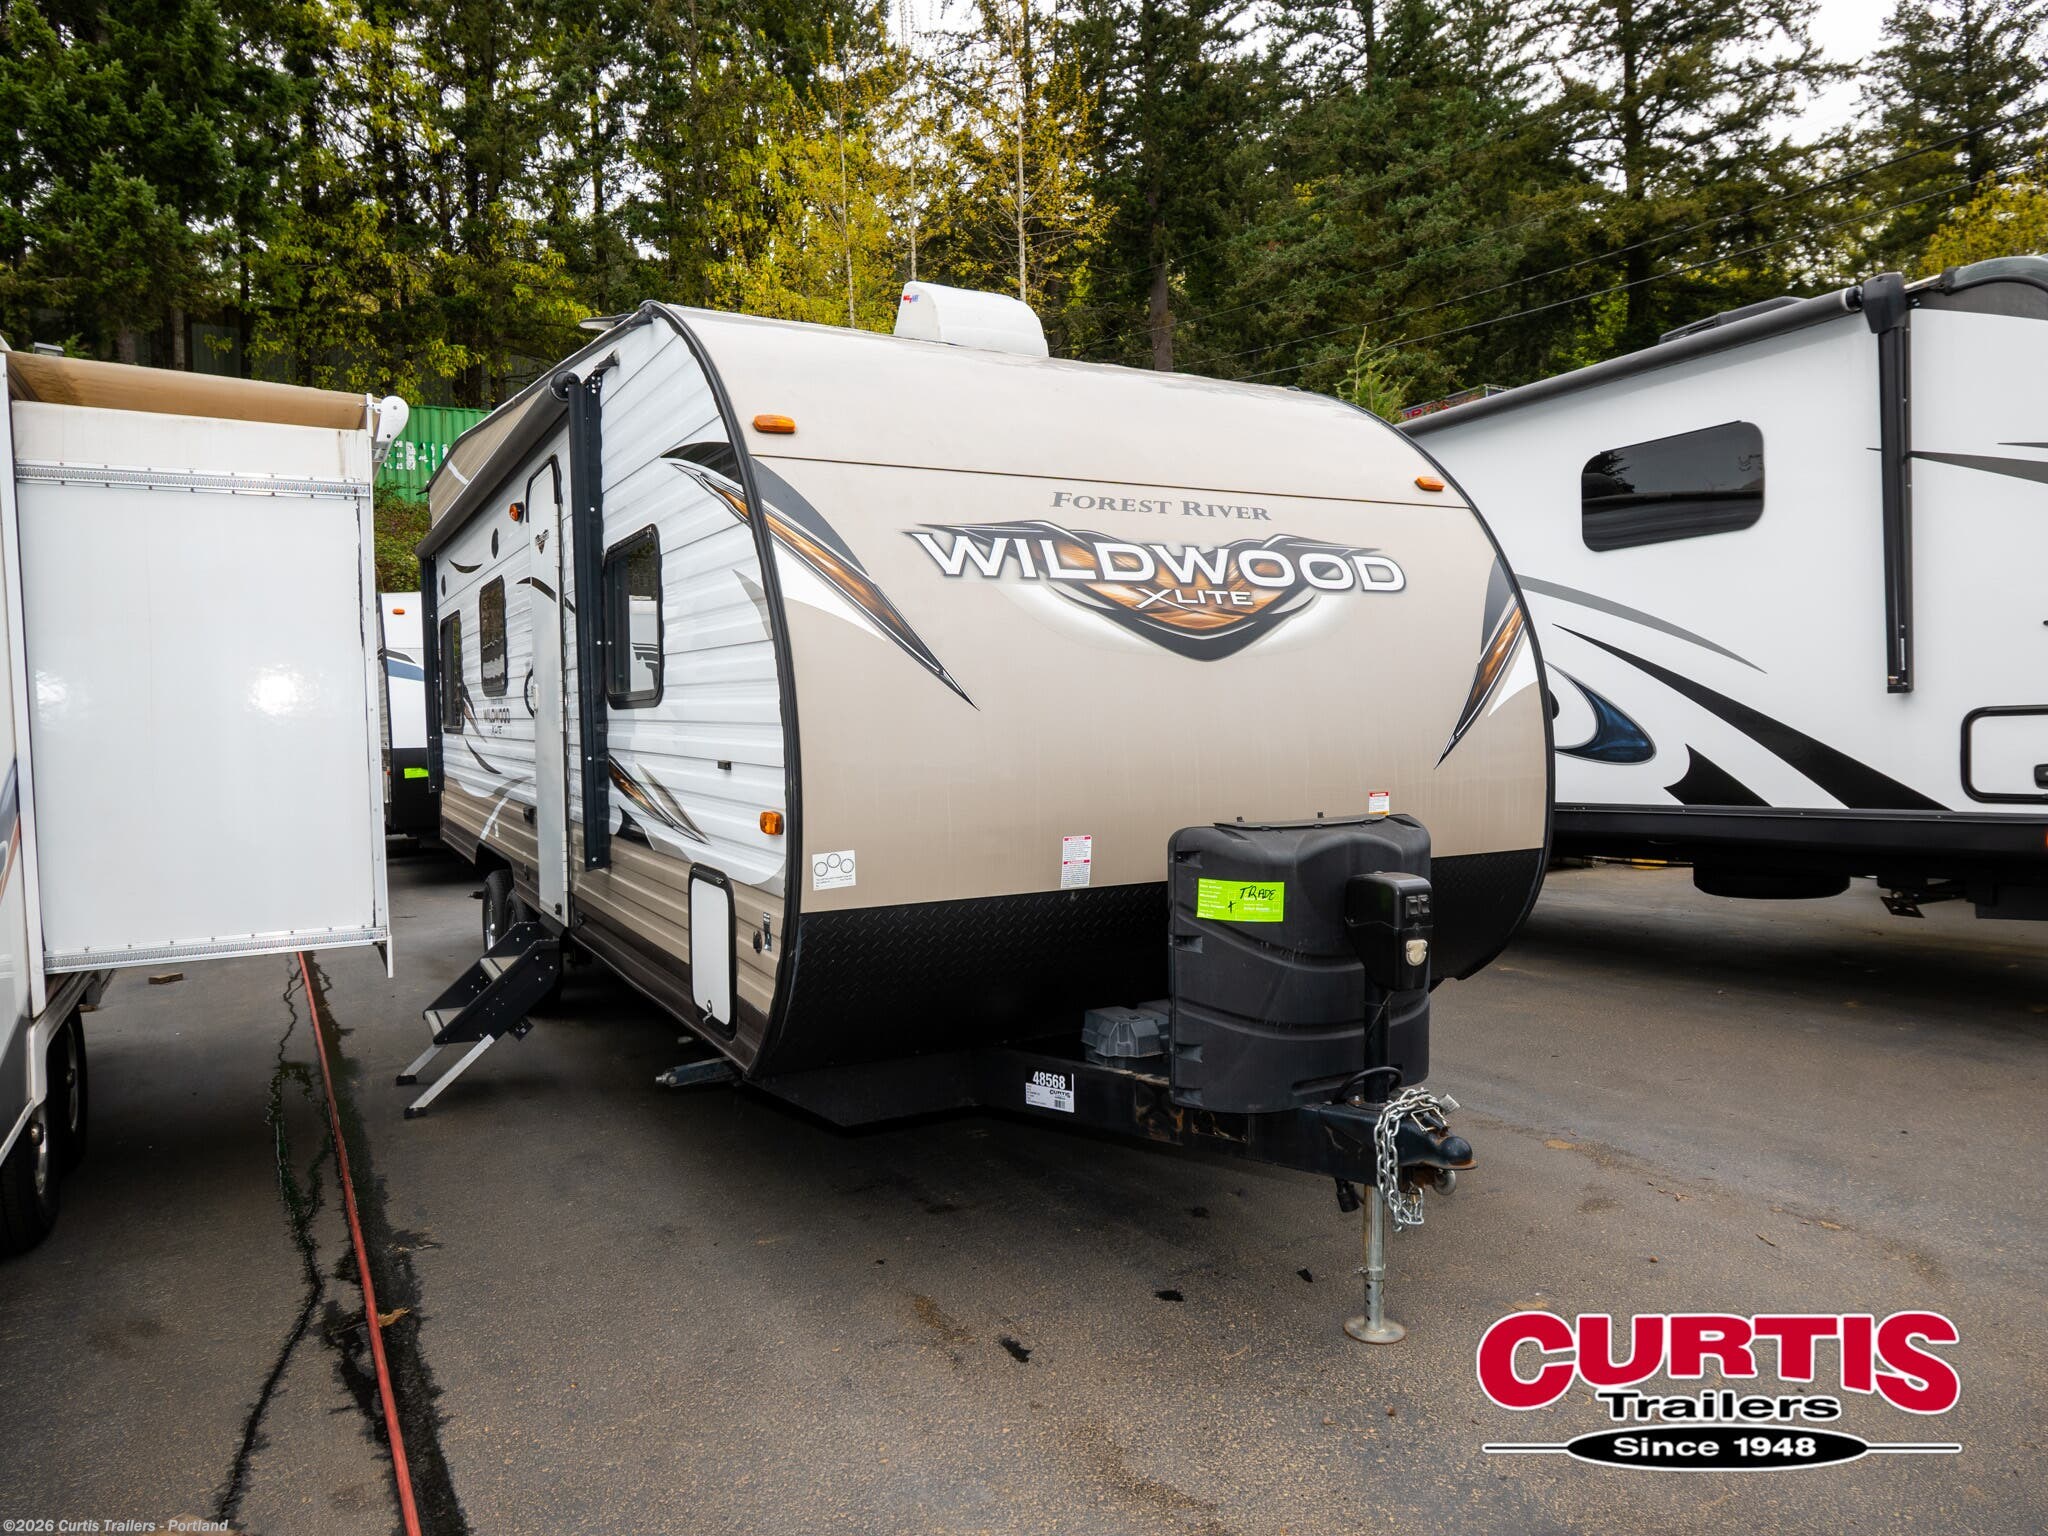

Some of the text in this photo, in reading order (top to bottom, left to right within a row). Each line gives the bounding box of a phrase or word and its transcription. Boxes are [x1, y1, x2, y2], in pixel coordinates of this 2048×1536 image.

[1051, 491, 1272, 521] FOREST RIVER
[902, 529, 1406, 593] WILDWOOD
[1239, 885, 1277, 901] TRADE
[1032, 1071, 1066, 1090] 48568
